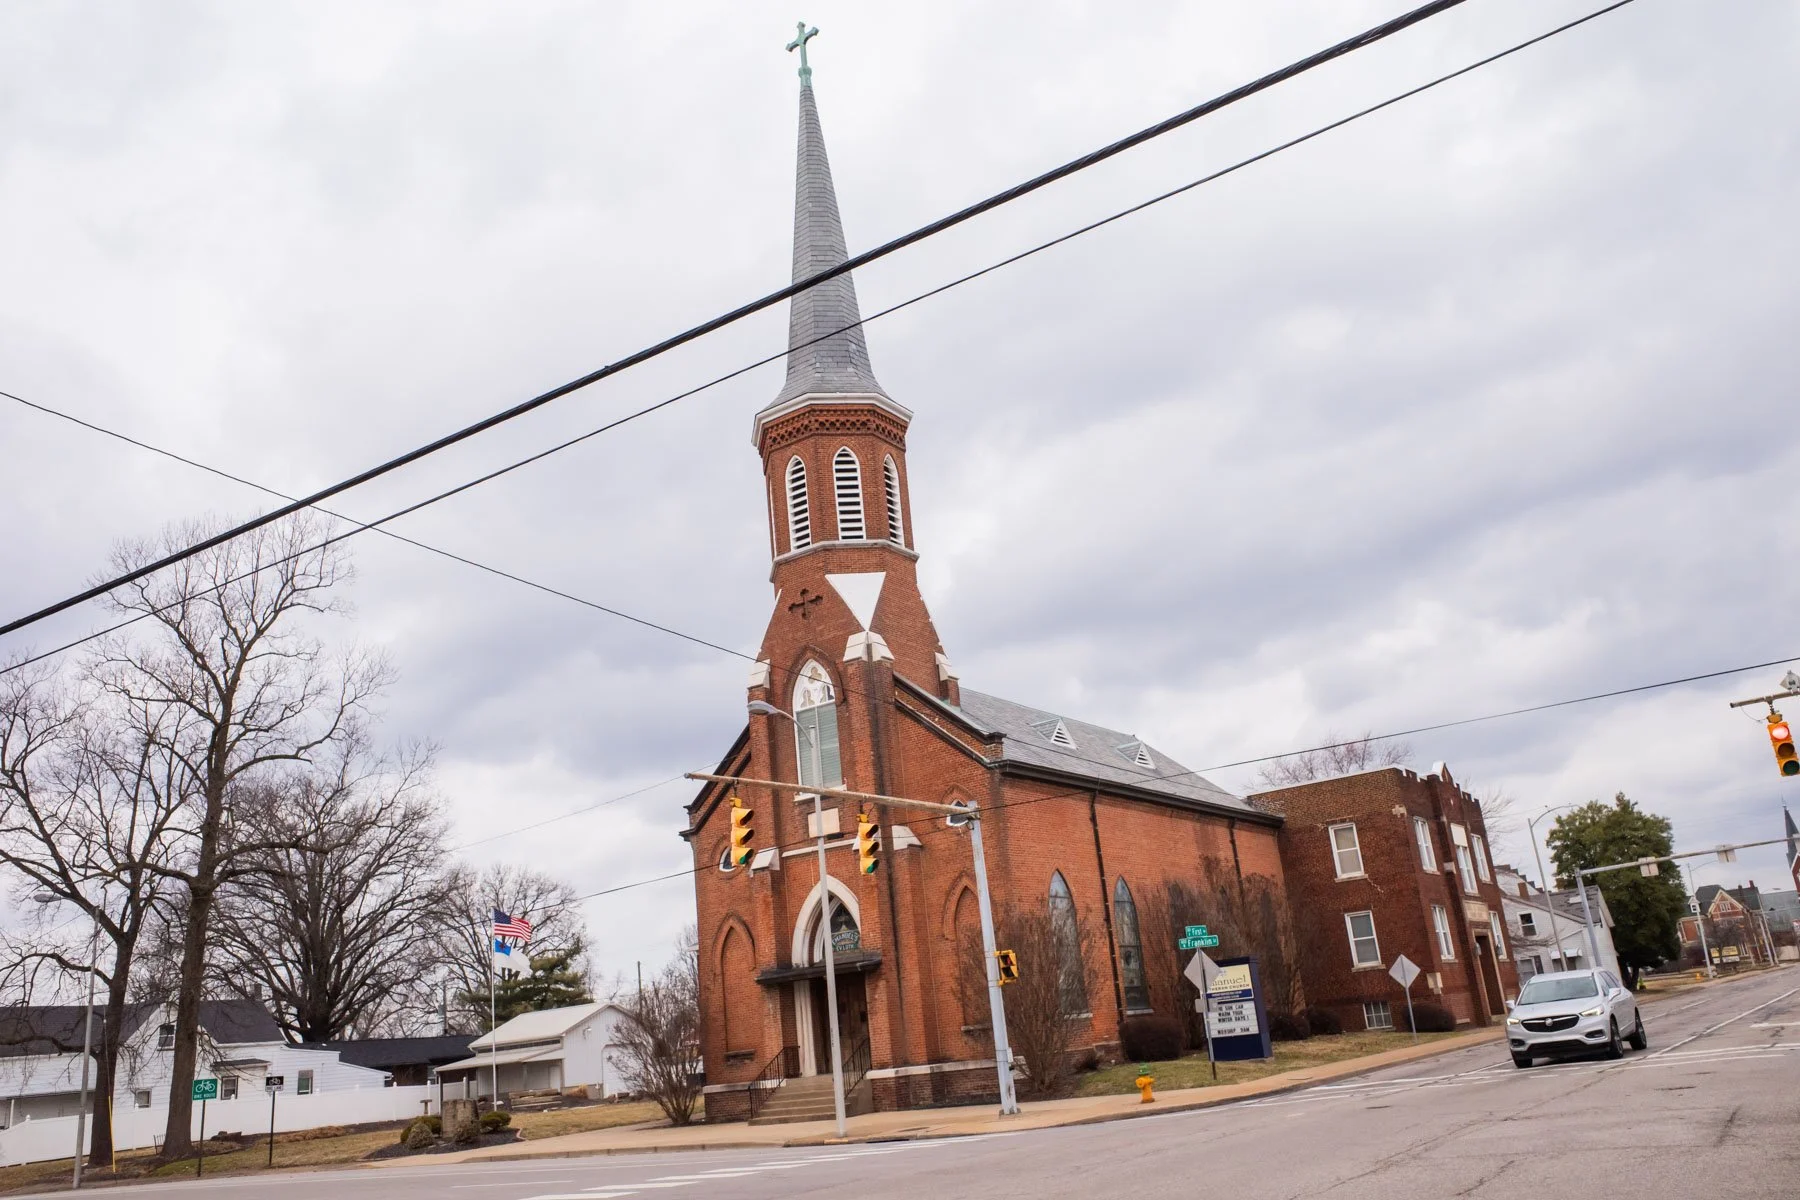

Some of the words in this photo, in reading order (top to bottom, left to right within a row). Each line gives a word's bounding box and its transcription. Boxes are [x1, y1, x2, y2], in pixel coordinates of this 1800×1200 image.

[1192, 928, 1203, 936] First
[1187, 938, 1213, 947] Franklin
[1212, 975, 1246, 986] manuel
